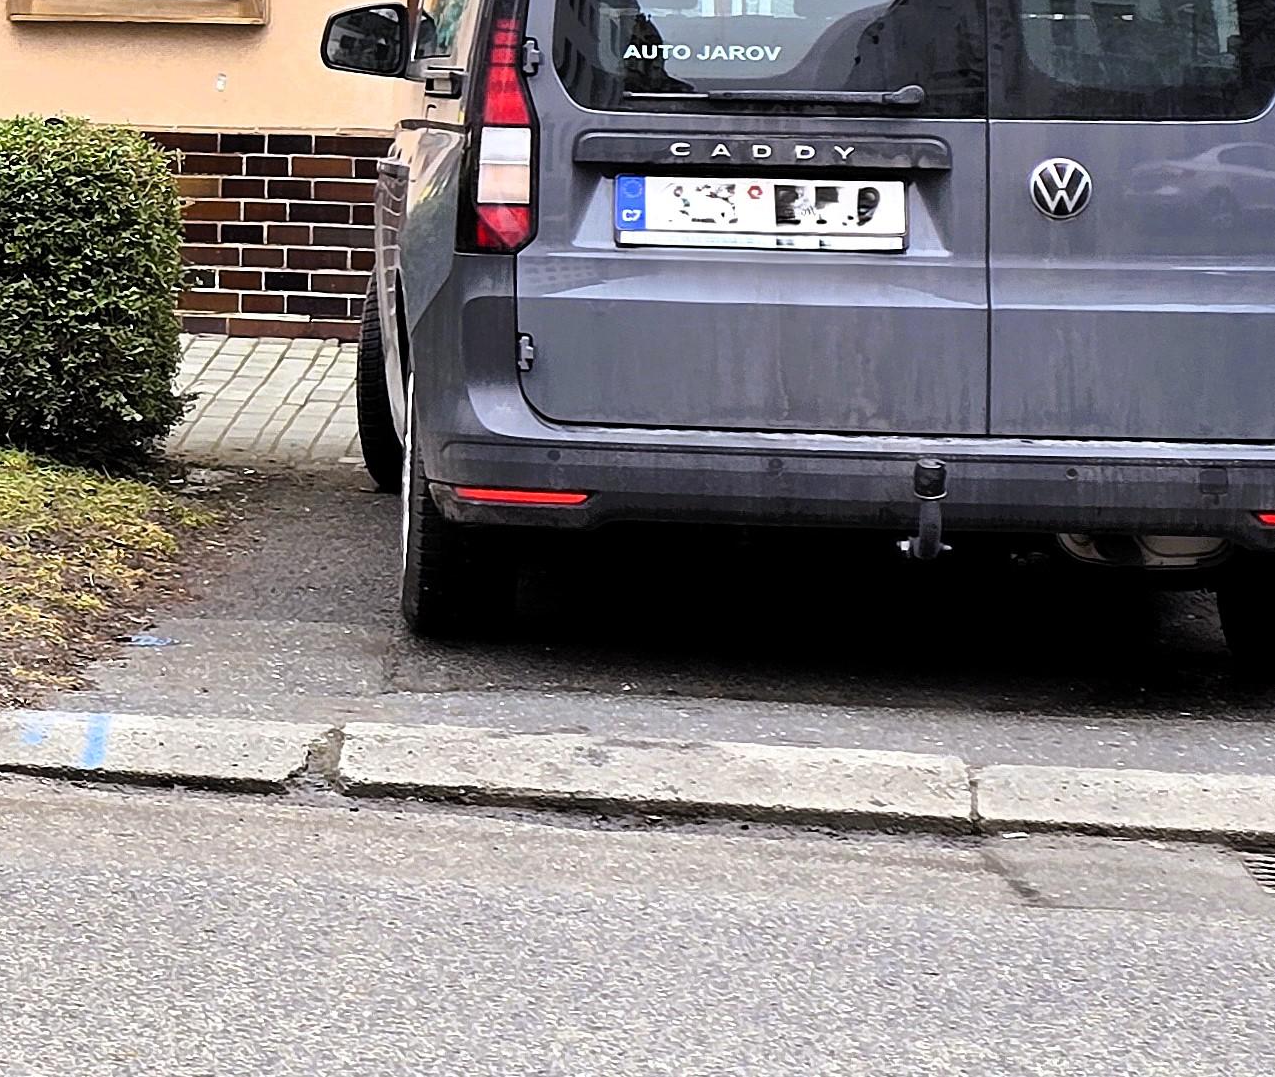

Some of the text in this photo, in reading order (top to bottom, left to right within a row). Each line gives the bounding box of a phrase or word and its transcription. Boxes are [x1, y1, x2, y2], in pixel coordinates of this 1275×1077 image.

[623, 44, 782, 61] AUTO JAROV
[669, 142, 855, 160] CADDY
